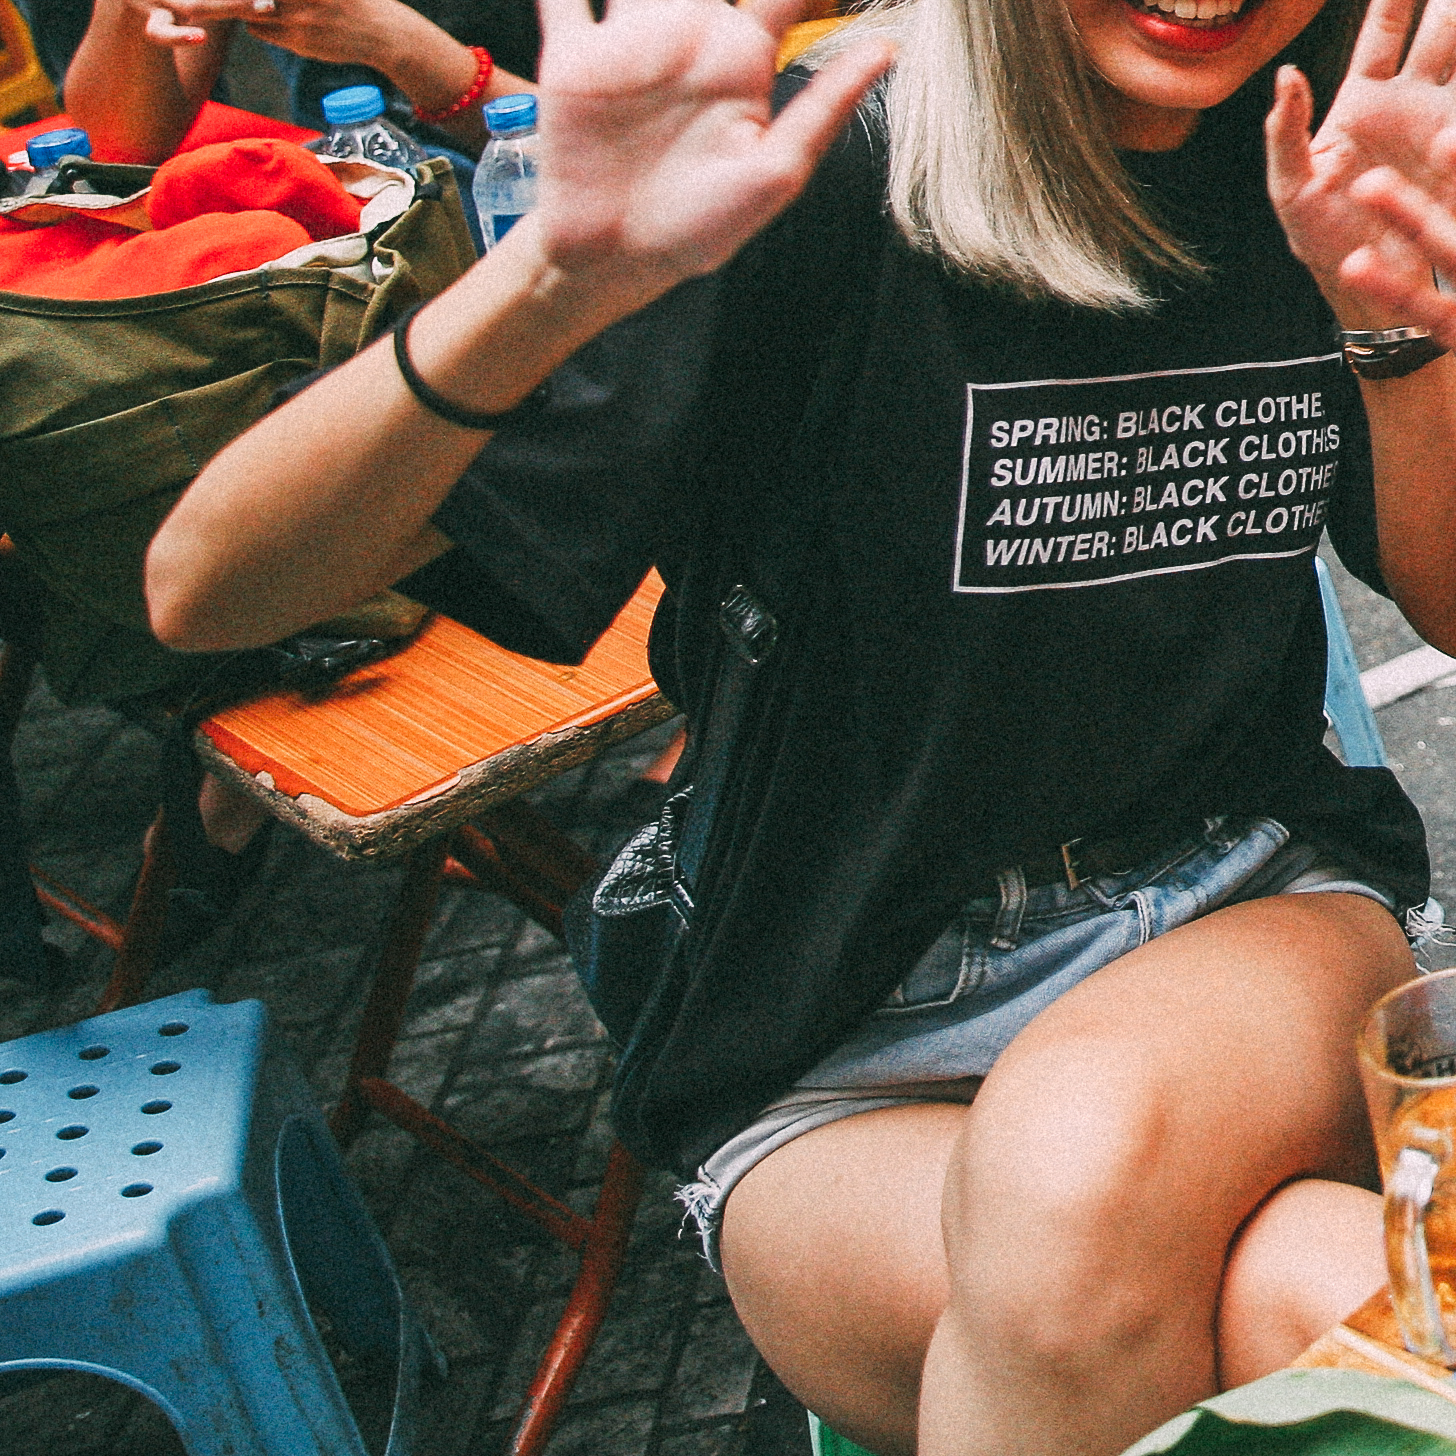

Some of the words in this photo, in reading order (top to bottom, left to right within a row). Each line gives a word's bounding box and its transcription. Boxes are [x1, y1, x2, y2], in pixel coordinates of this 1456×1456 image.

[990, 413, 1109, 448] SPRING:
[1116, 403, 1207, 439] BLACK
[1215, 392, 1325, 428] CLOTHE
[990, 451, 1128, 487] SUMMER:
[1135, 437, 1230, 475] BLACK
[986, 490, 1128, 527] AUTUMN:
[1132, 475, 1230, 514] BLACK
[1237, 461, 1338, 500] CLOTHE
[985, 531, 1116, 566] WINTER:
[1122, 514, 1221, 554] BLACK
[1226, 498, 1330, 537] CLOTHE
